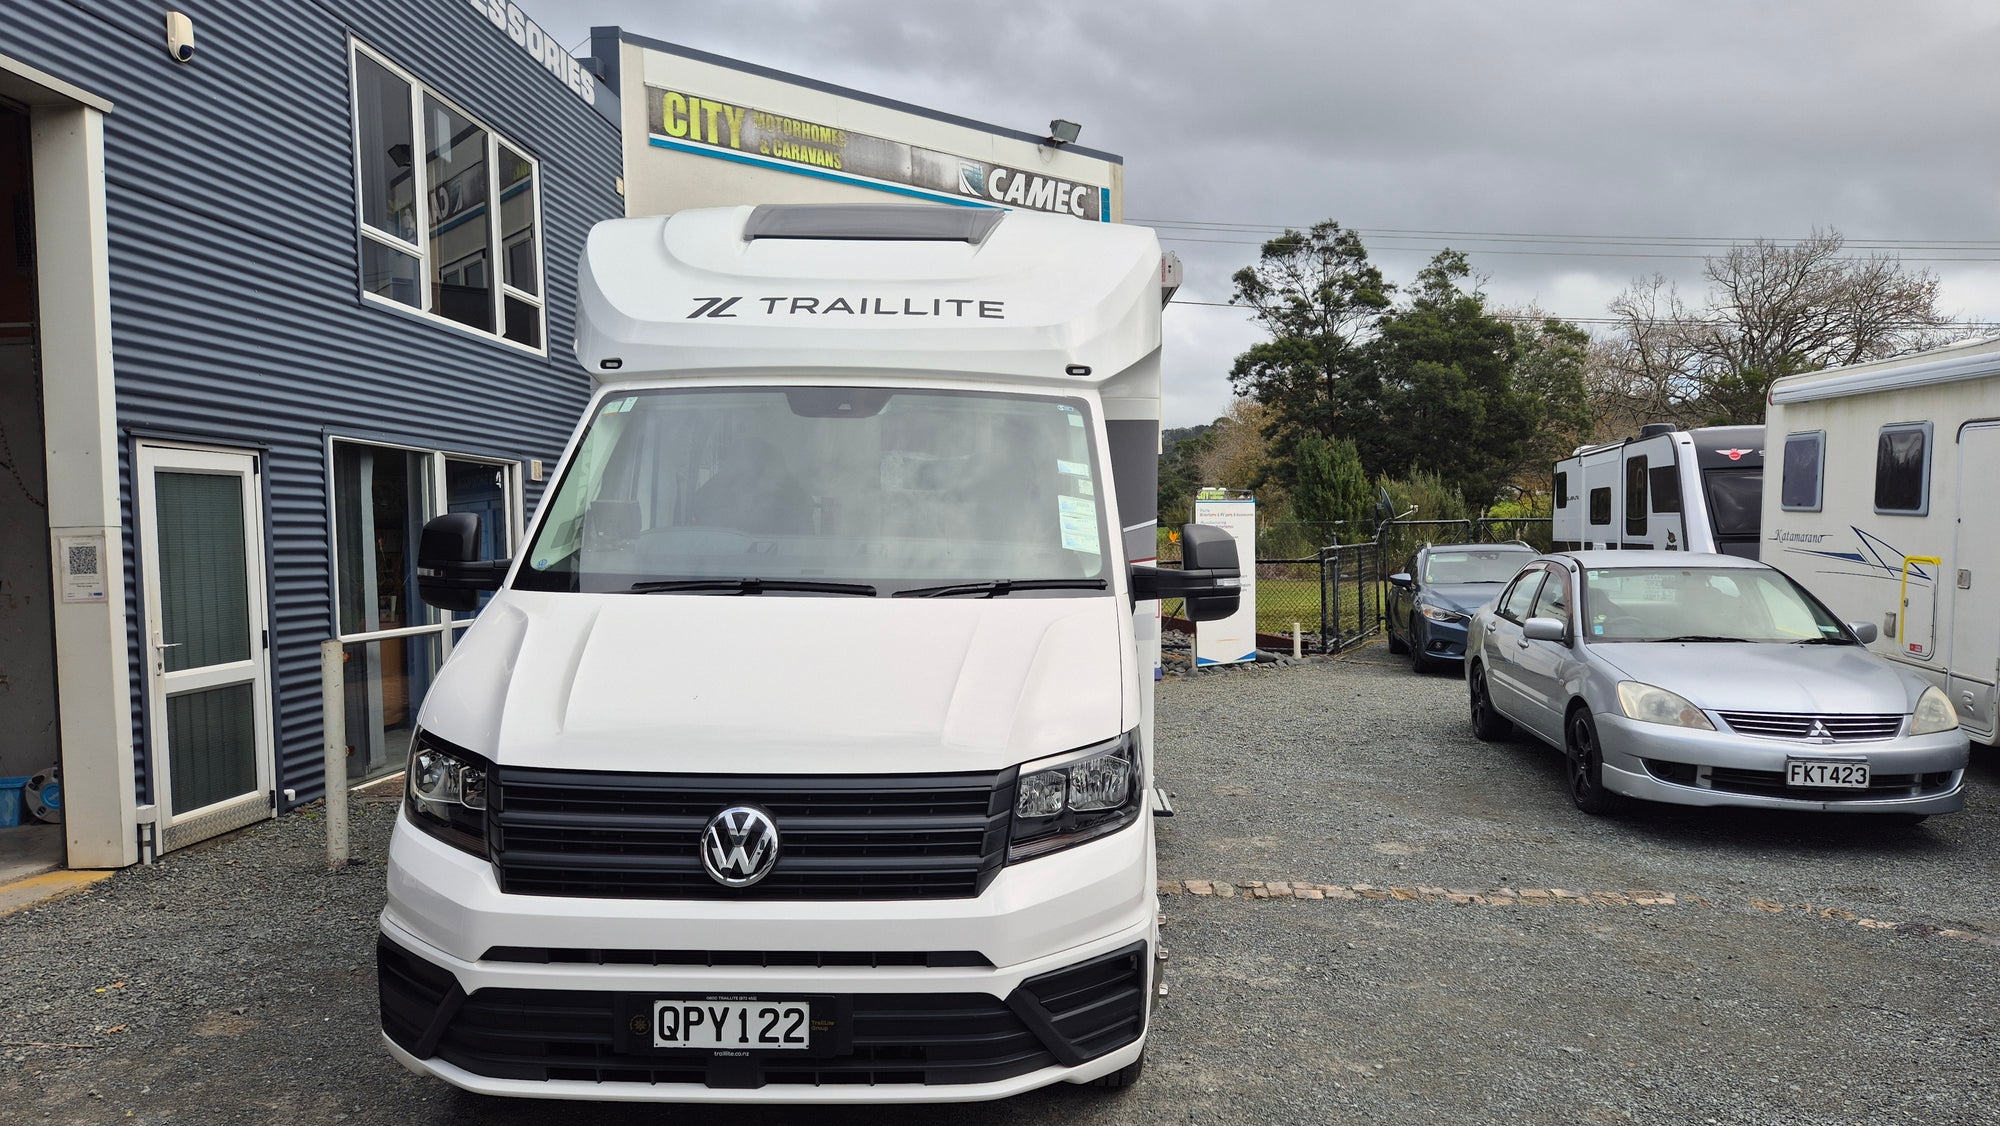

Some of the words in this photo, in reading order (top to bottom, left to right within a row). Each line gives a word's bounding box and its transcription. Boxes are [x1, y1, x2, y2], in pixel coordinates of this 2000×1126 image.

[470, 0, 595, 105] SSORIES
[662, 91, 746, 149] CITY
[752, 111, 847, 148] MOTORHOMES
[760, 139, 770, 155] &
[773, 142, 842, 170] CARAVANS
[988, 168, 1087, 217] CAMEC
[759, 297, 1005, 320] TRAILLITE
[1770, 529, 1828, 543] Katamarano
[1790, 765, 1867, 784] FKT423
[658, 1005, 805, 1044] QPY122
